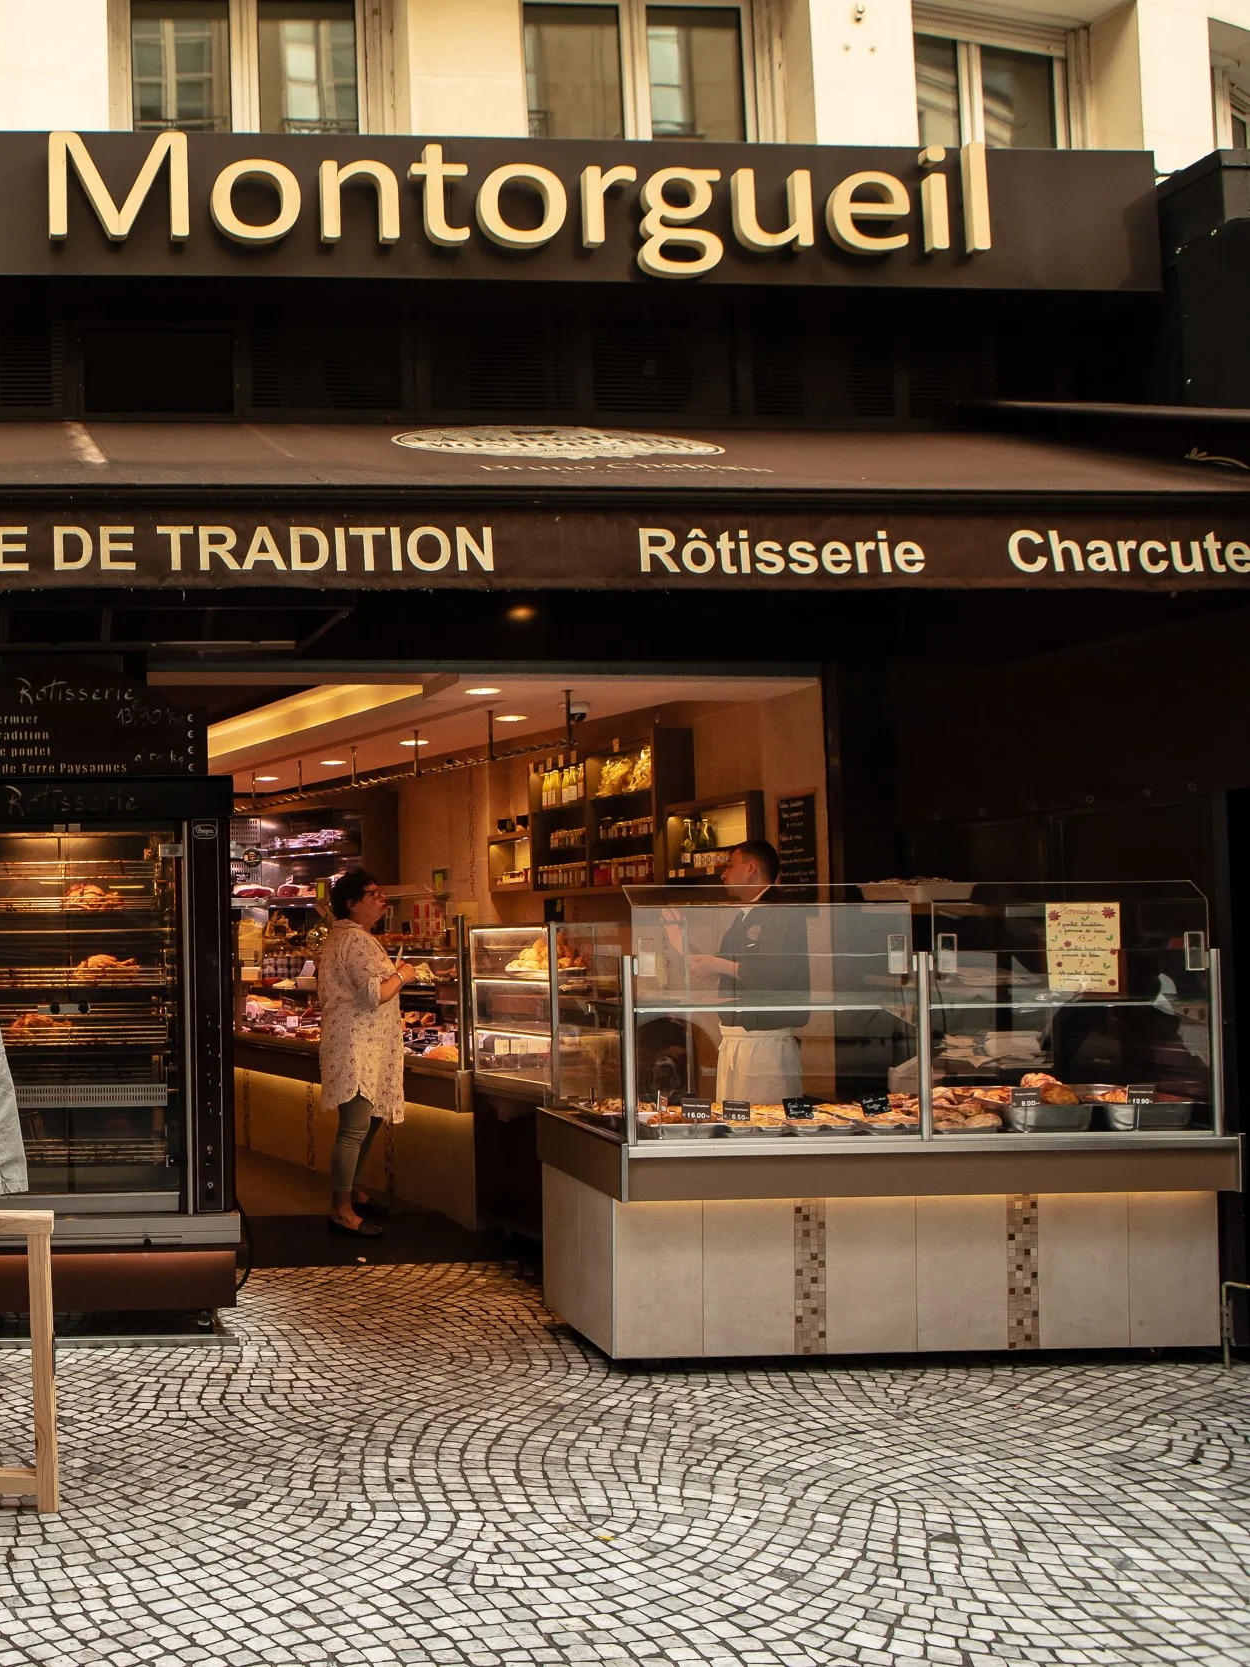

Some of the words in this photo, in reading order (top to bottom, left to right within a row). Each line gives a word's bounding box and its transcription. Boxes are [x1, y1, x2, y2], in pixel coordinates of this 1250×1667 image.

[48, 130, 991, 279] Montorgueil
[479, 463, 596, 472] Bruno
[606, 461, 776, 474] Chaplain
[53, 525, 137, 572] DE
[157, 525, 494, 573] TRADITION
[638, 527, 926, 575] Rôtisserie
[1007, 529, 1250, 574] Charcute
[2, 763, 16, 775] de
[21, 762, 55, 774] Terre
[59, 761, 128, 775] Paysannes
[11, 746, 51, 759] poulet
